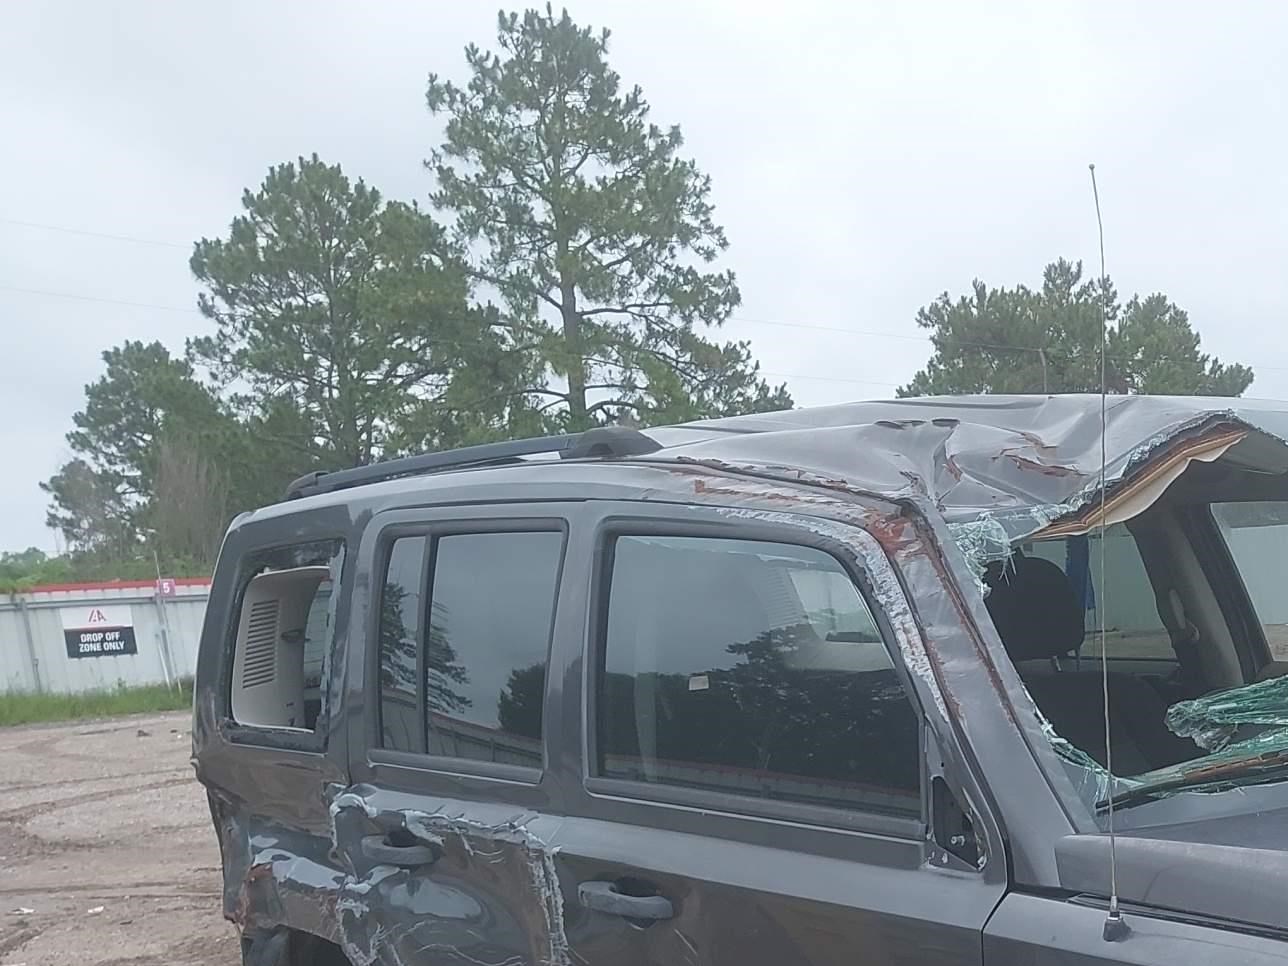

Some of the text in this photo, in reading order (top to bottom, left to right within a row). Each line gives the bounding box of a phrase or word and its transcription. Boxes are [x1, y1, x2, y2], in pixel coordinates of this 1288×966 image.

[163, 582, 170, 594] 5
[80, 631, 121, 643] DROP OFF
[79, 641, 125, 653] ZONE ONLY
